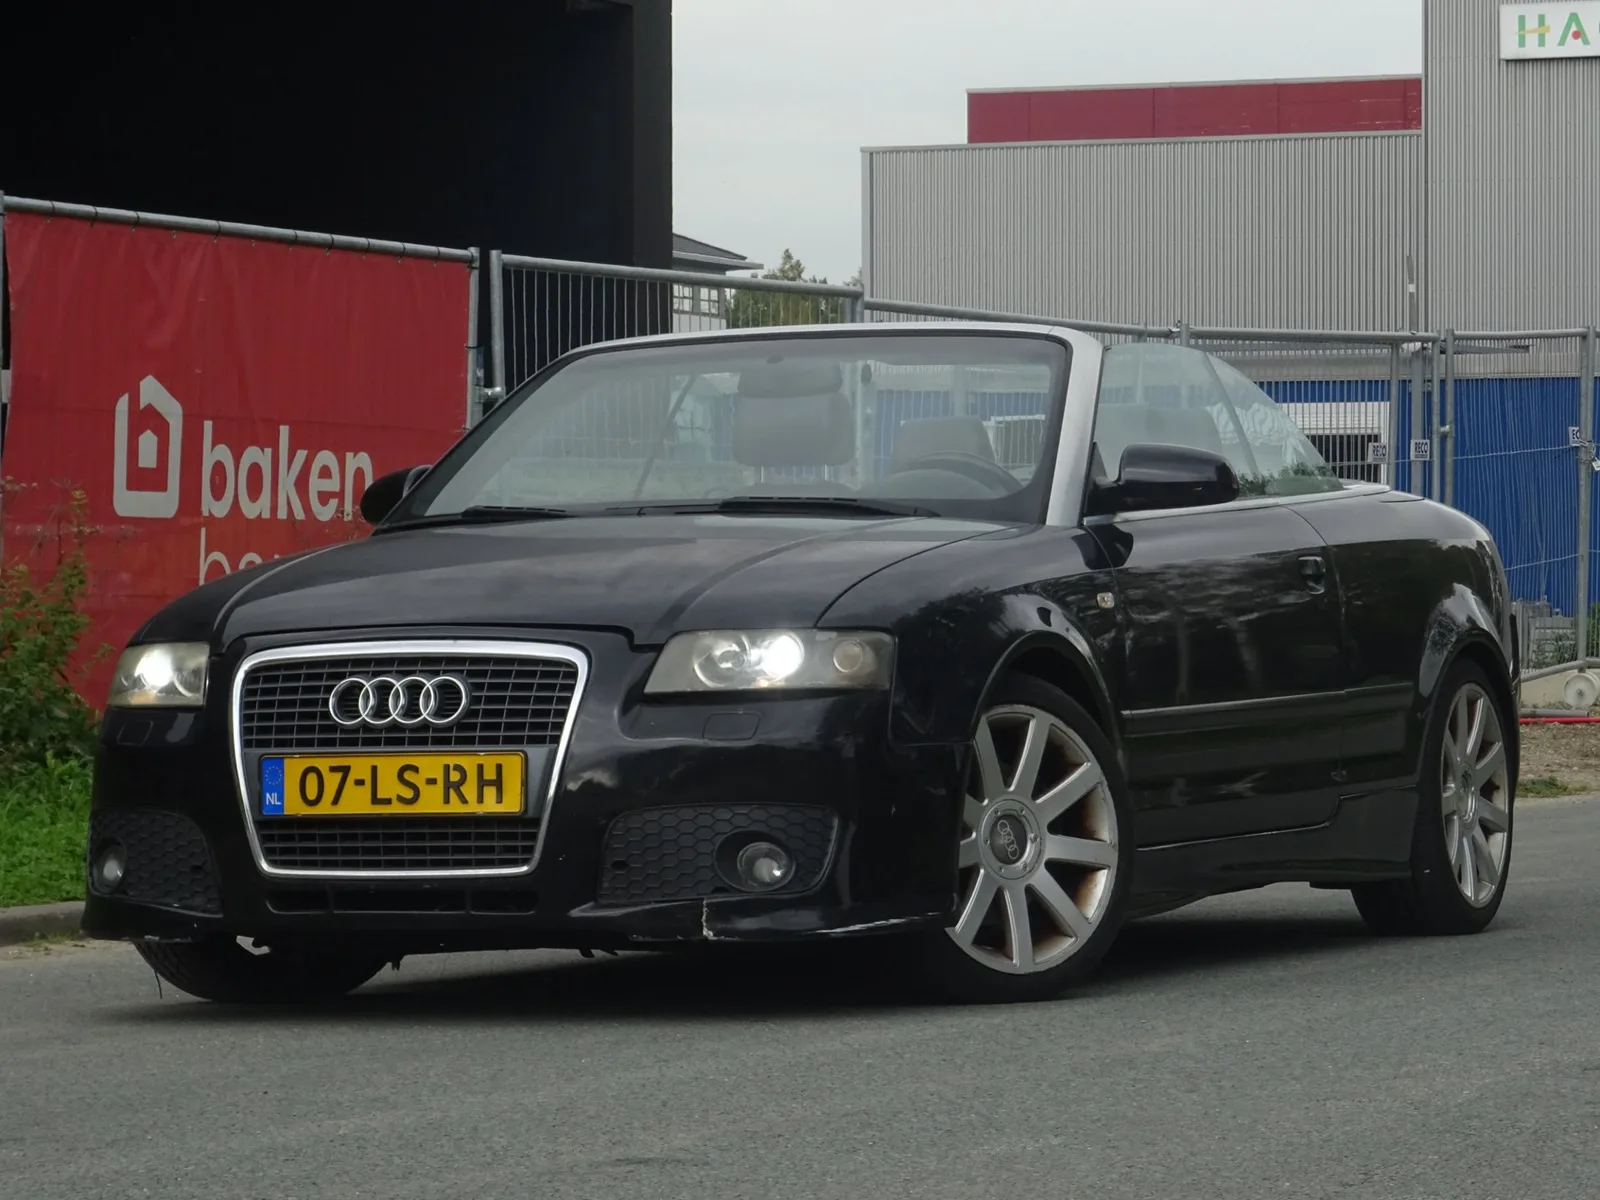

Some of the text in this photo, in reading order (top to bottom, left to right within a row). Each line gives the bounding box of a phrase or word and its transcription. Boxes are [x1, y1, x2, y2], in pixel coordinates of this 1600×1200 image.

[1515, 12, 1600, 48] HA
[201, 420, 374, 521] baken
[265, 792, 281, 805] NL
[298, 763, 503, 807] 07-LS-RH
